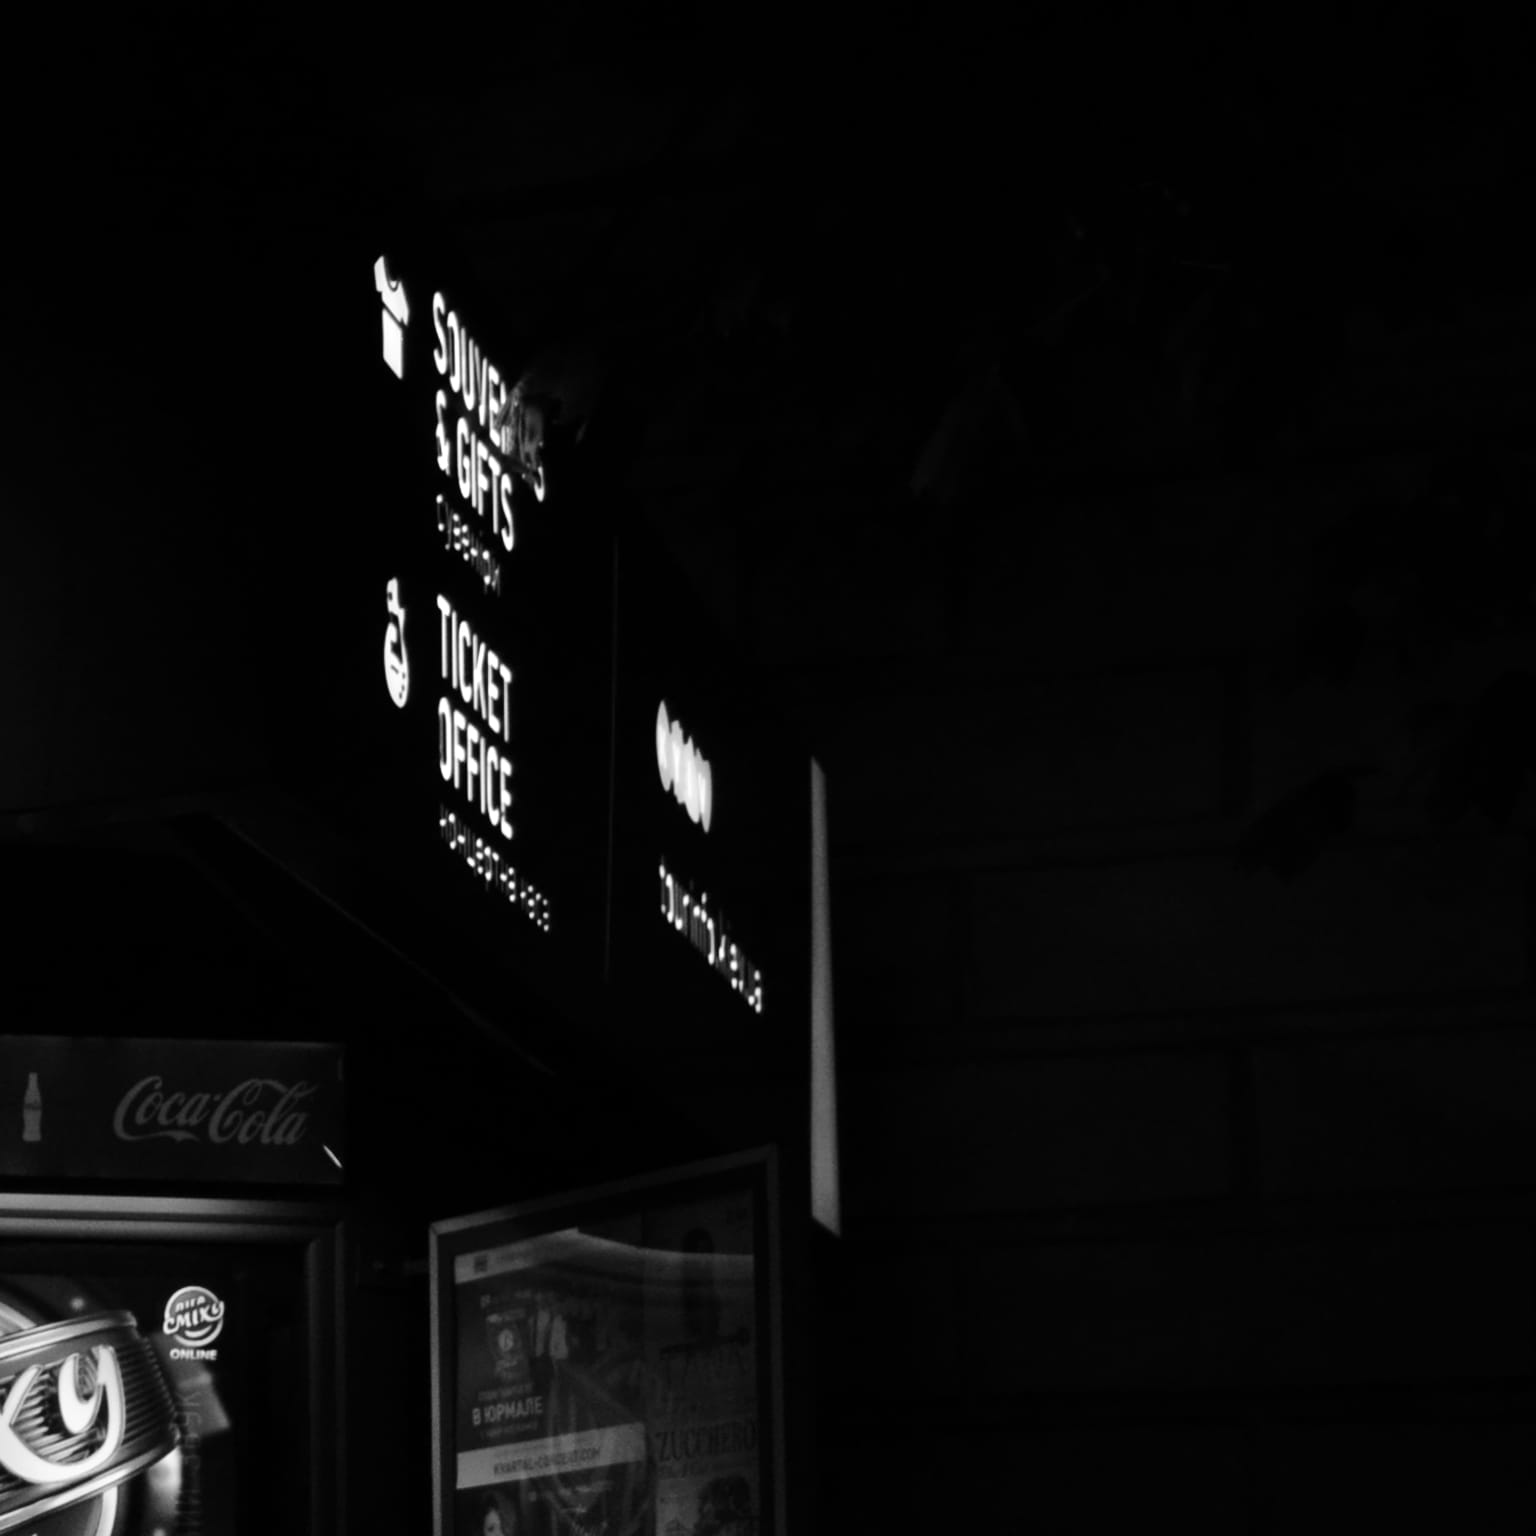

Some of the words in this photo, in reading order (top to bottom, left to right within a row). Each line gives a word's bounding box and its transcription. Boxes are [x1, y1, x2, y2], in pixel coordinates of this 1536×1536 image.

[456, 416, 516, 552] GIFTS
[437, 594, 512, 743] TICKET
[438, 697, 513, 839] OFFICE
[112, 1072, 319, 1148] Coca-Cola
[169, 1347, 218, 1361] ONLINE
